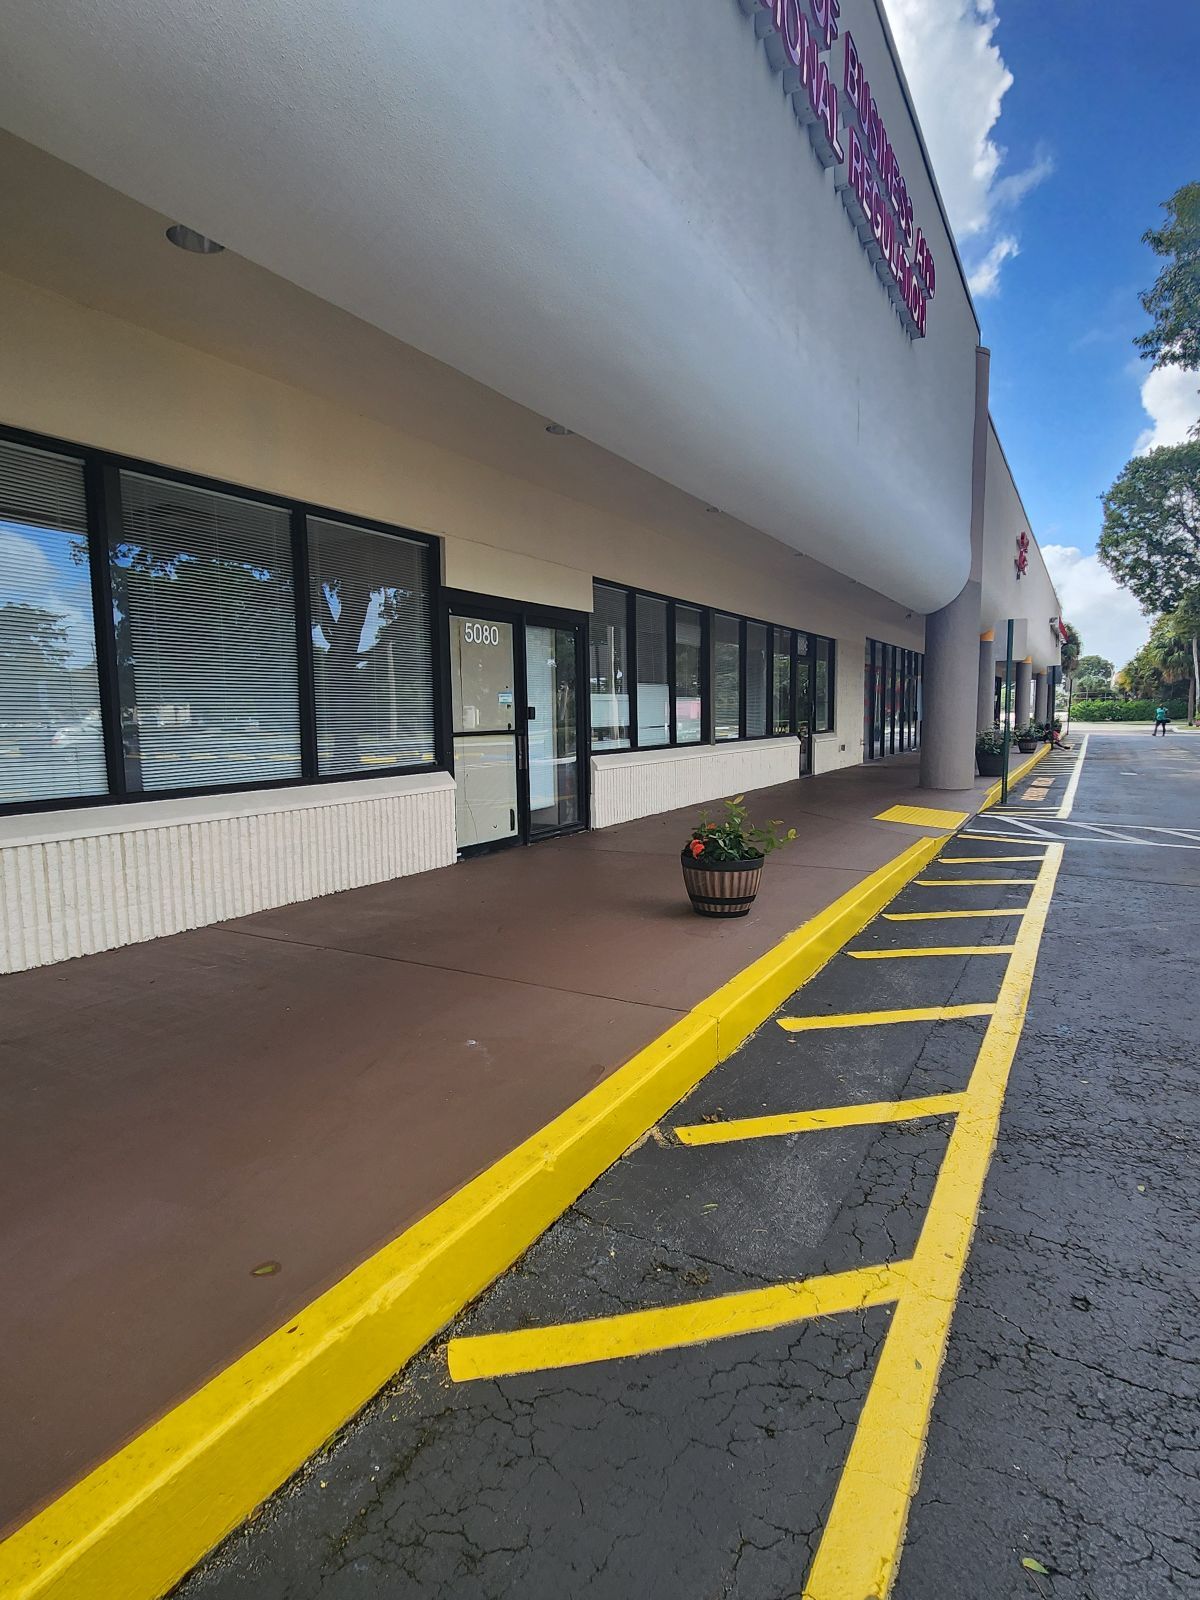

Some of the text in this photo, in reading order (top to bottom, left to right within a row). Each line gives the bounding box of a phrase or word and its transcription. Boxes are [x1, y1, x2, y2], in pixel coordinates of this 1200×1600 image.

[844, 30, 913, 248] BUSINESS
[915, 227, 935, 299] AND
[848, 126, 926, 337] REGULATION
[464, 622, 499, 645] 5080
